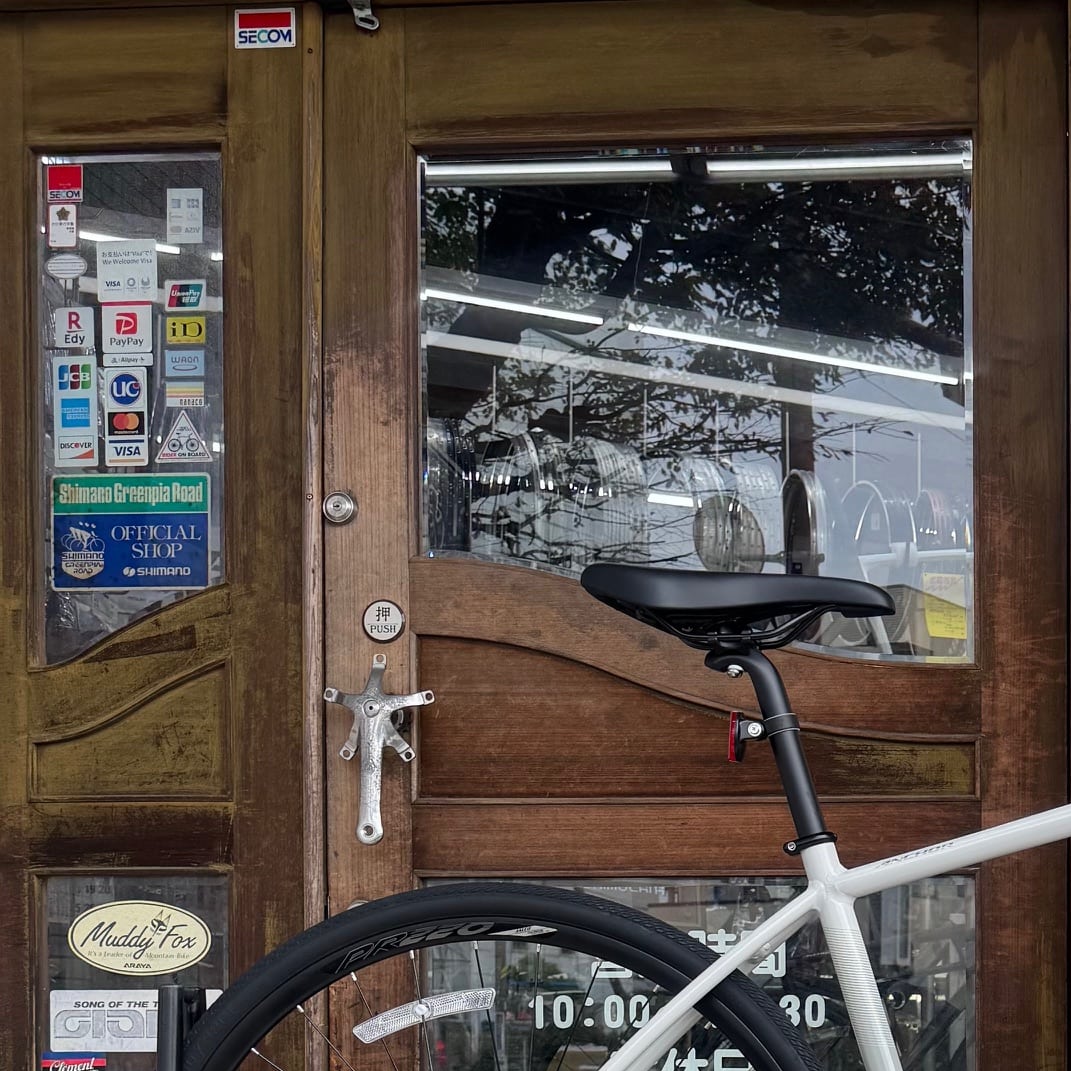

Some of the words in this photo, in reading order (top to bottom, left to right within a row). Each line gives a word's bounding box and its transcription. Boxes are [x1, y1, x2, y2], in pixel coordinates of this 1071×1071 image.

[238, 29, 292, 44] SECOM
[50, 190, 80, 198] SECOM
[170, 322, 203, 337] iD
[64, 334, 86, 345] Edy
[110, 337, 144, 347] PayPay
[58, 372, 91, 382] JCB
[113, 381, 140, 397] UC
[114, 446, 141, 456] VISA
[59, 483, 112, 504] Shimano
[113, 482, 170, 506] Greenpia
[172, 481, 203, 503] Road
[111, 525, 201, 541] OFFICIAL
[131, 543, 183, 558] SHOP
[137, 566, 191, 576] SHIMANO
[375, 606, 391, 622] 押
[370, 625, 397, 634] PUSH
[80, 921, 155, 960] Muddy
[158, 924, 197, 949] Fox
